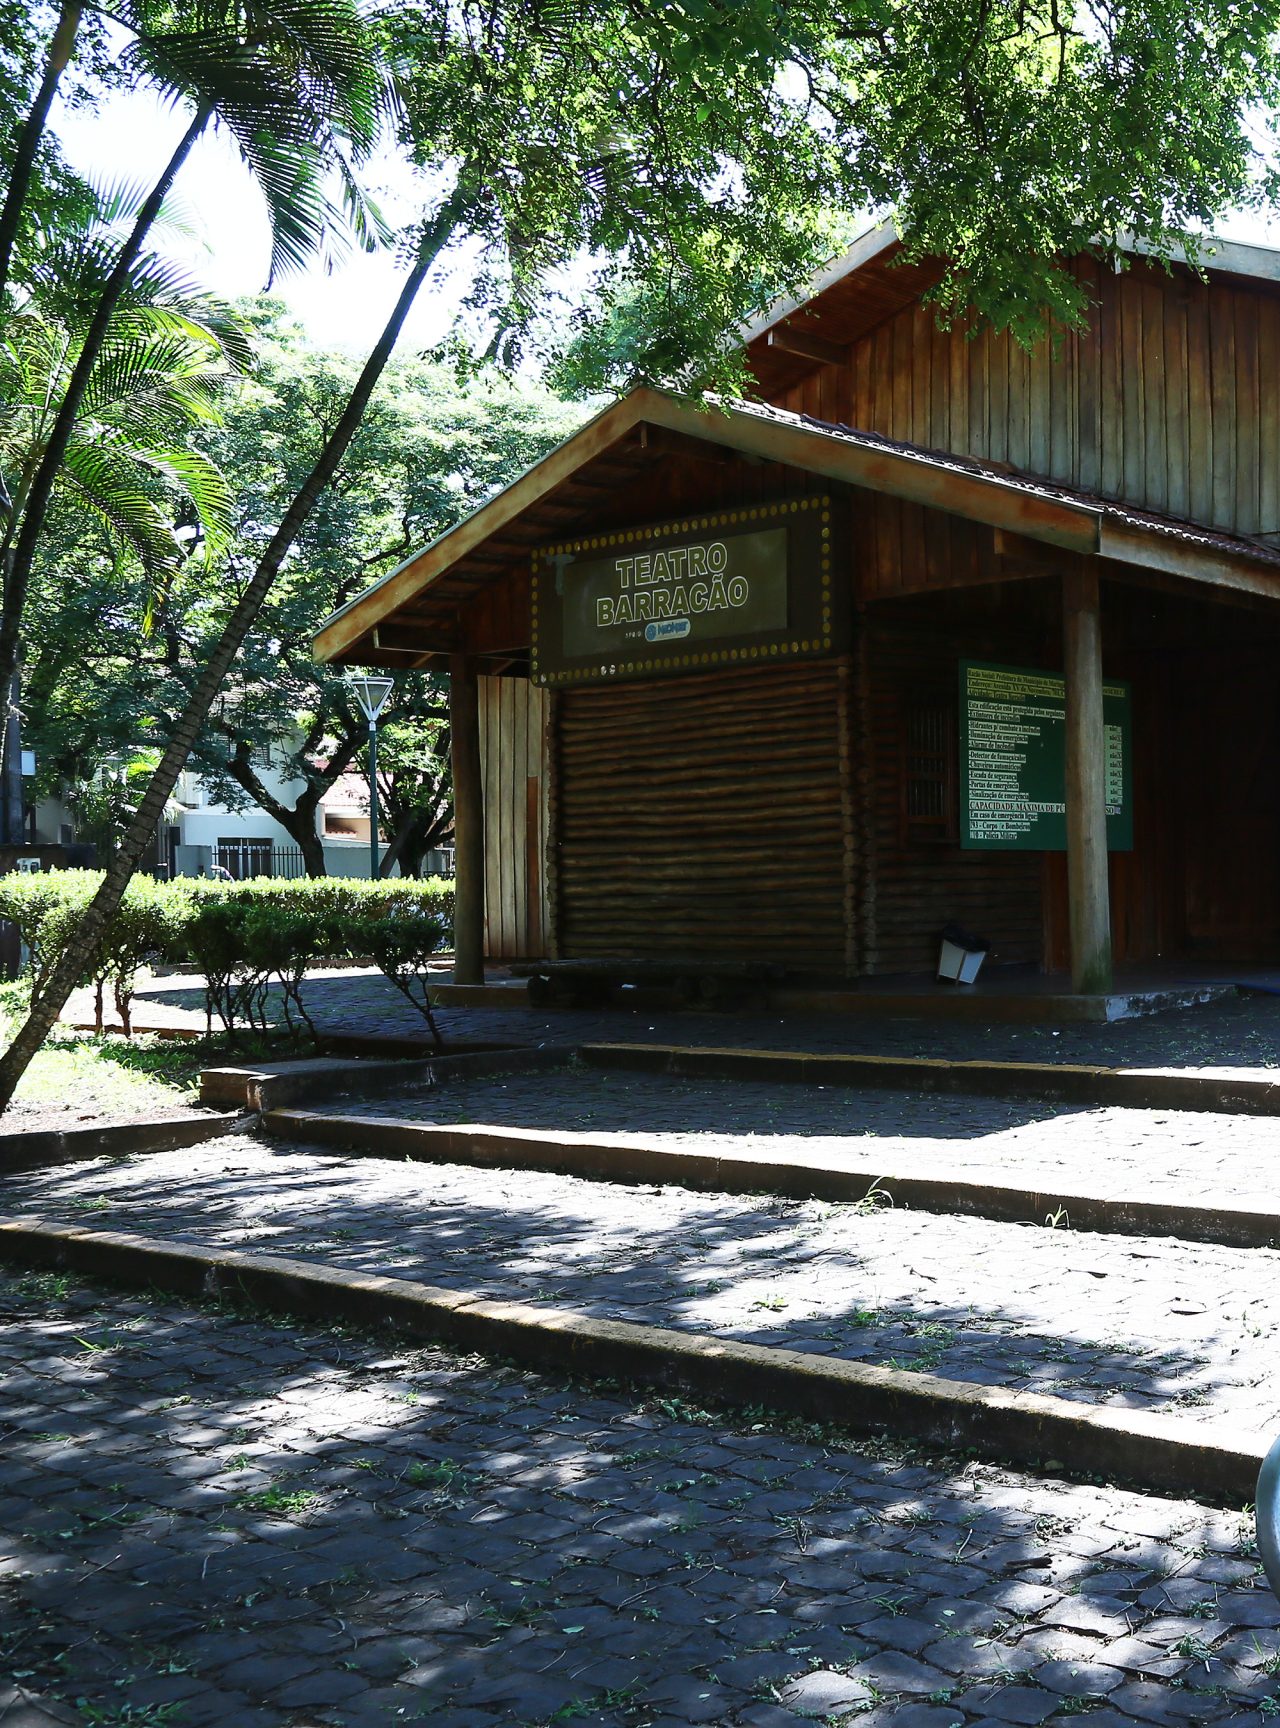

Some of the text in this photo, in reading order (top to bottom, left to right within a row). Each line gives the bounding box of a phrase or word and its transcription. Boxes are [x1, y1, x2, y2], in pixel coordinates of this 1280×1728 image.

[616, 542, 728, 589] TEATRO
[596, 573, 749, 627] BARRACÃO
[979, 702, 1002, 711] edificação
[970, 801, 1015, 810] CAPACIDADE
[1016, 802, 1045, 812] MÁXIMA
[982, 822, 998, 830] Corpo
